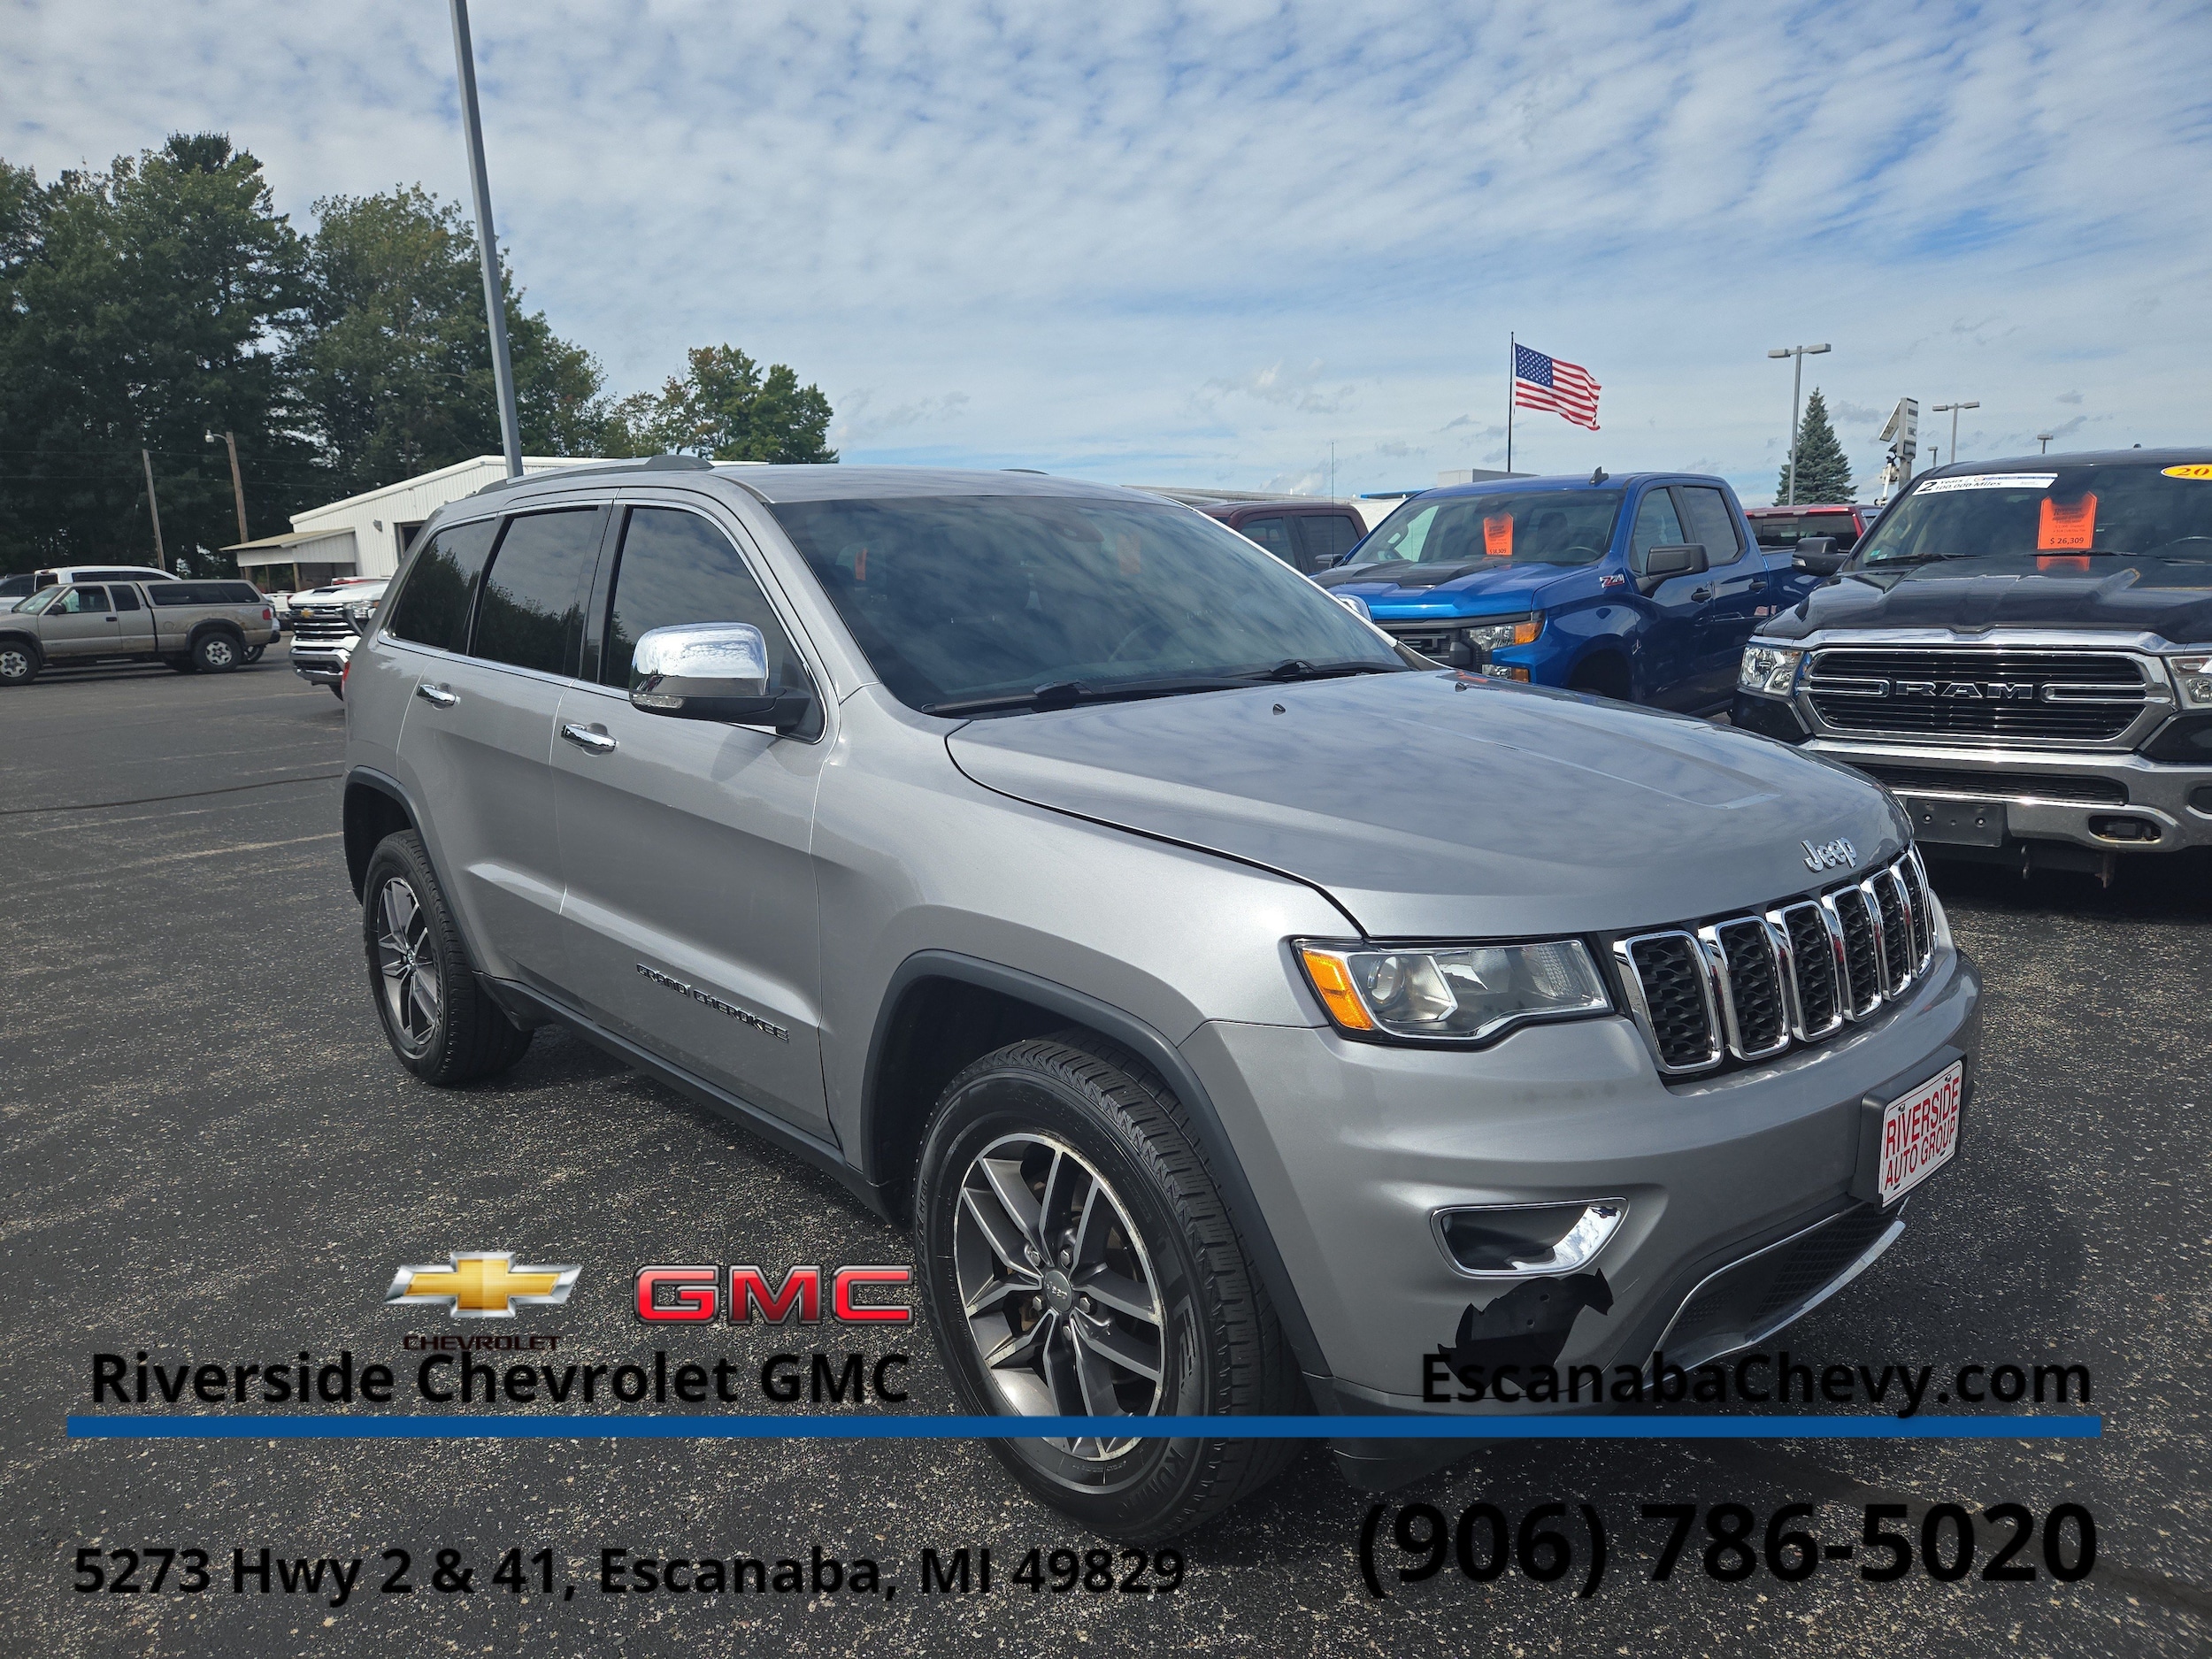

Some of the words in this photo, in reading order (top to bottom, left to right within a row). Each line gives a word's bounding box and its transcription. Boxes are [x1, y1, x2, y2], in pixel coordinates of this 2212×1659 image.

[1917, 481, 1938, 493] 2
[1895, 680, 2034, 700] RAM
[1800, 837, 1857, 873] Jeep
[636, 963, 692, 998] GRAND
[693, 988, 790, 1043] CHEROKEE
[1886, 1076, 1960, 1160] RIVERSIDE
[1885, 1142, 1918, 1191] AUTO
[1920, 1115, 1956, 1166] GROUP
